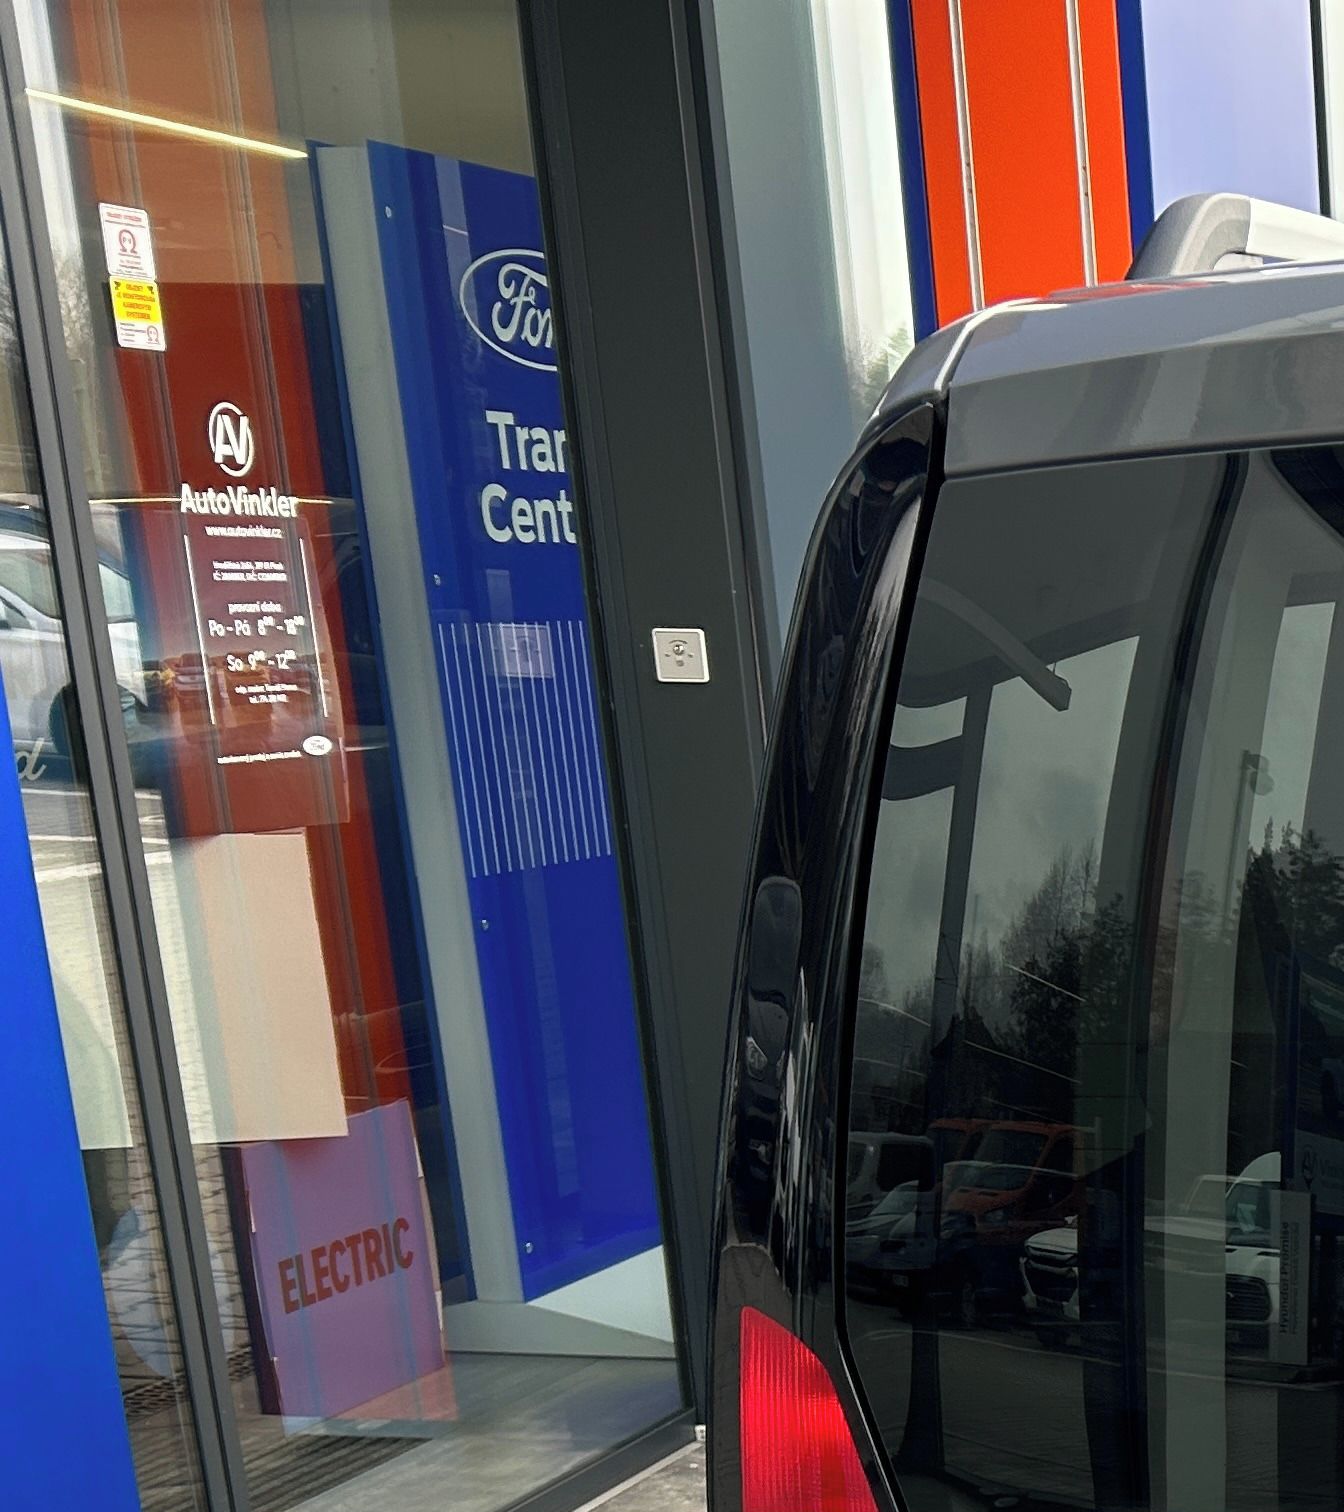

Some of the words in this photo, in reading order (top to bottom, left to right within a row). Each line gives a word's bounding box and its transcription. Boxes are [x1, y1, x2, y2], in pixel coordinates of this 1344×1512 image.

[492, 263, 553, 348] For
[181, 483, 299, 518] AutoVinkler
[481, 483, 577, 544] Cent
[278, 1217, 414, 1315] ELECTRIC
